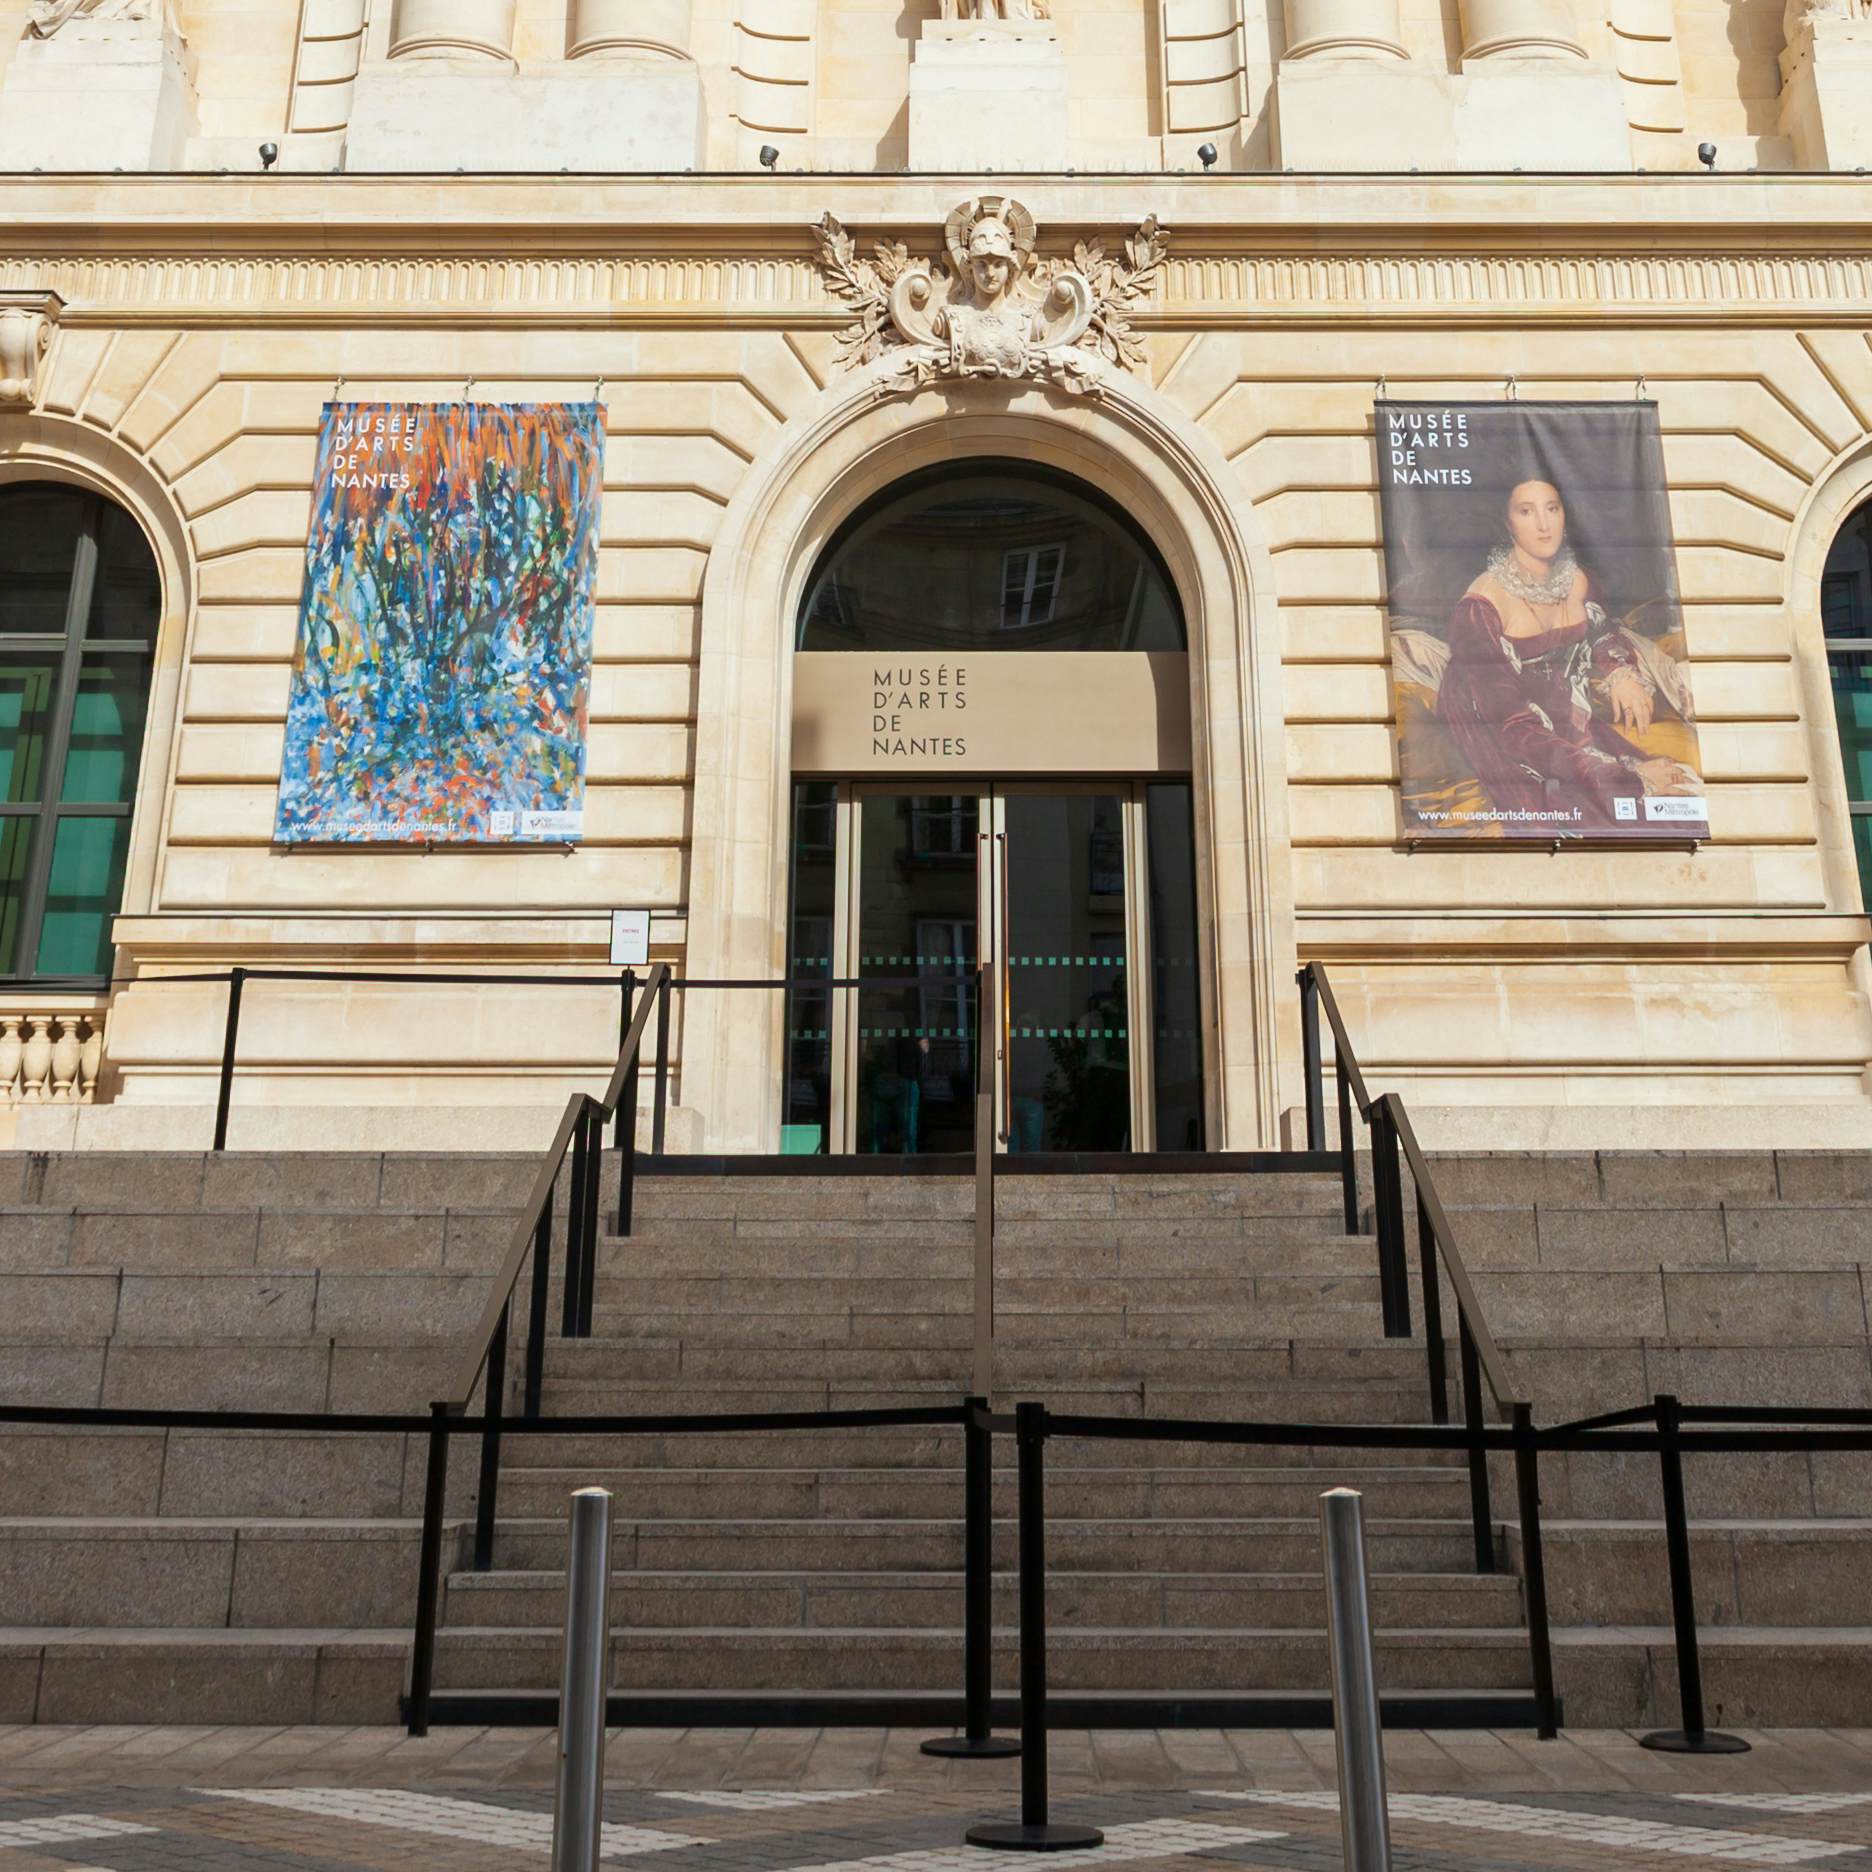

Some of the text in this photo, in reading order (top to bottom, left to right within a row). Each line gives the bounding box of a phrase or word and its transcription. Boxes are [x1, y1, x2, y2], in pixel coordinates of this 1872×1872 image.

[337, 413, 417, 434] MUSÉE
[1389, 409, 1468, 429] MUSÉE
[335, 435, 415, 452] D'ARTS
[1390, 431, 1470, 448] D'ARTS
[333, 454, 358, 470] DE
[1391, 450, 1417, 466] DE
[331, 472, 411, 489] NANTES
[1392, 468, 1473, 485] NANTES
[873, 663, 967, 687] MUSÉE
[873, 690, 967, 710] D'ARTS
[872, 714, 902, 732] DE
[872, 736, 967, 756] NANTES
[1417, 806, 1583, 821] www.museedartsdenantes.fr
[290, 817, 458, 832] www.museedartsdenantes.fr
